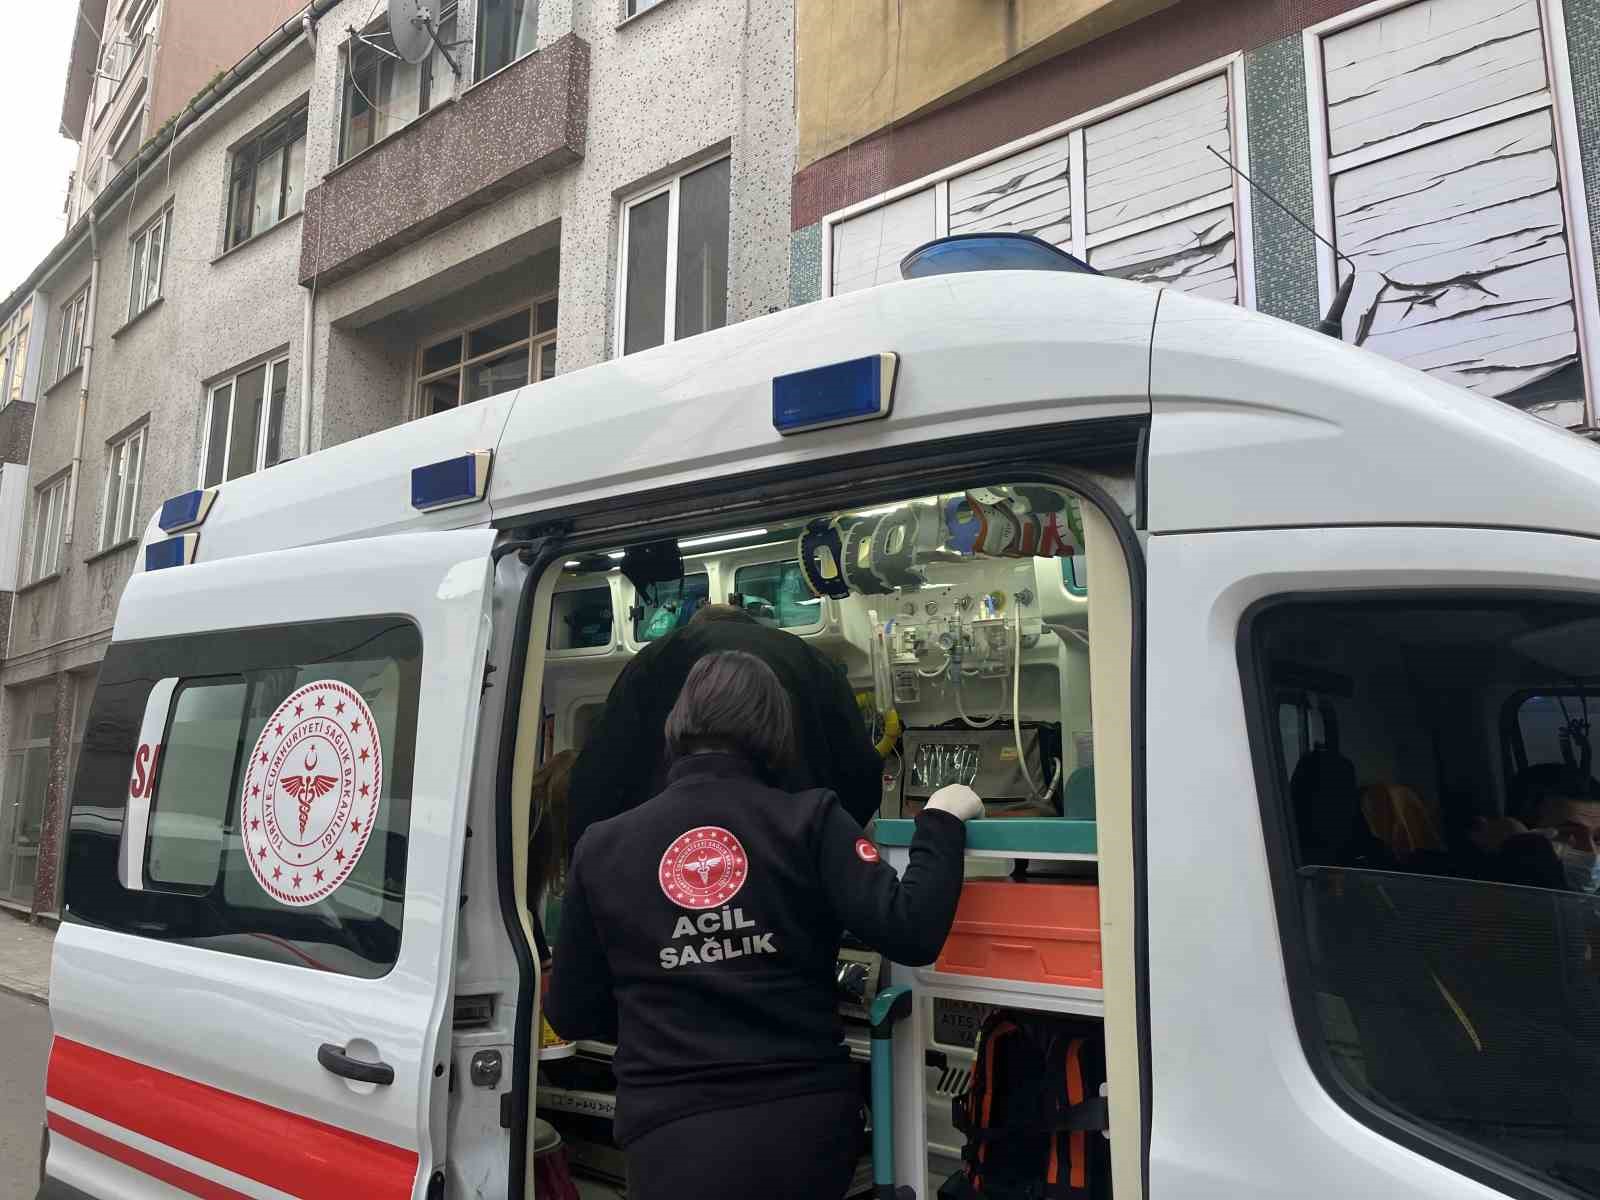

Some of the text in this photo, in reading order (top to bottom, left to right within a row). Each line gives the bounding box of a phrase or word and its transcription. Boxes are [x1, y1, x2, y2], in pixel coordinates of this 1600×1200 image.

[268, 720, 323, 788] CUMHURİYETİ
[324, 724, 350, 764] SAĞLIK
[321, 767, 352, 849] BAKANLIĞI
[672, 904, 755, 939] ACİL
[659, 932, 777, 969] SAĞLIK
